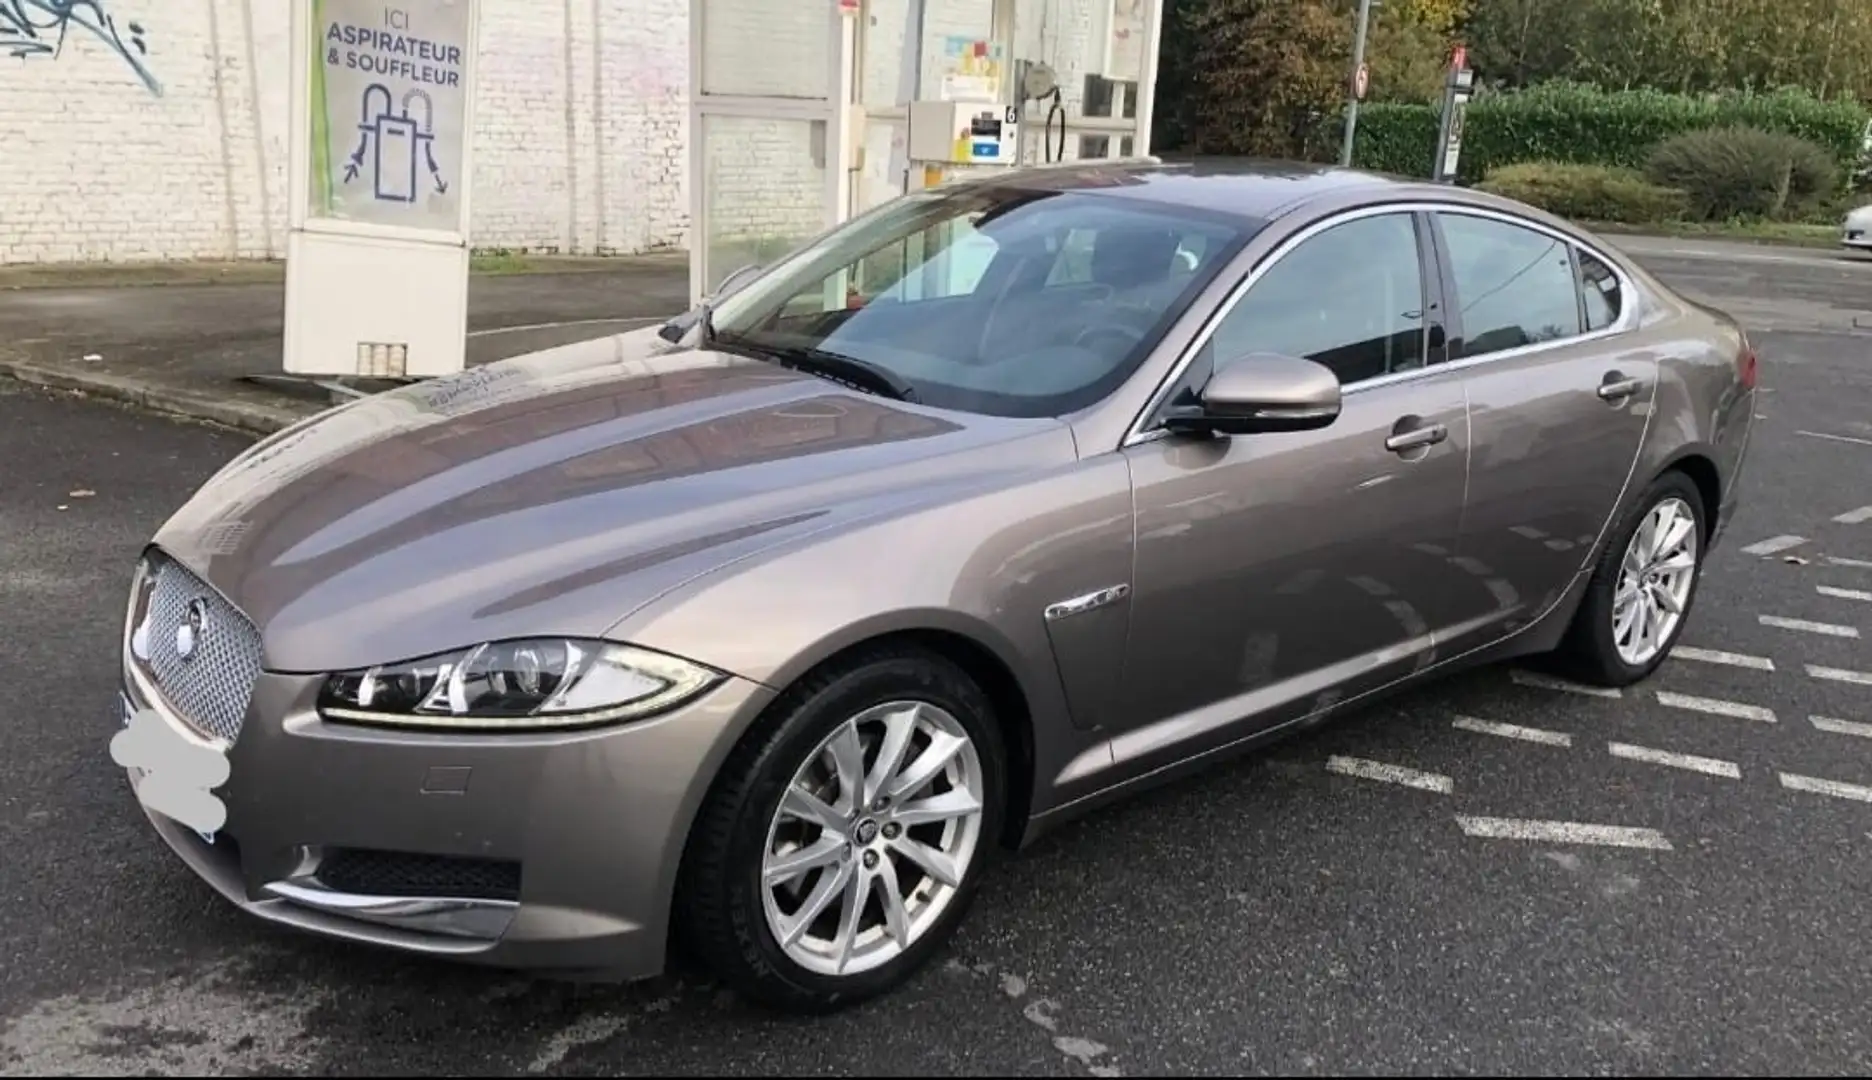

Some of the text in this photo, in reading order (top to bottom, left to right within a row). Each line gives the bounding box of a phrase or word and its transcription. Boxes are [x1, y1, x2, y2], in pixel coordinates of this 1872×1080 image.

[385, 6, 409, 31] ICI
[327, 22, 461, 65] ASPIRATEUR
[327, 48, 459, 87] & SOUFFLEUR
[1007, 107, 1016, 123] 6
